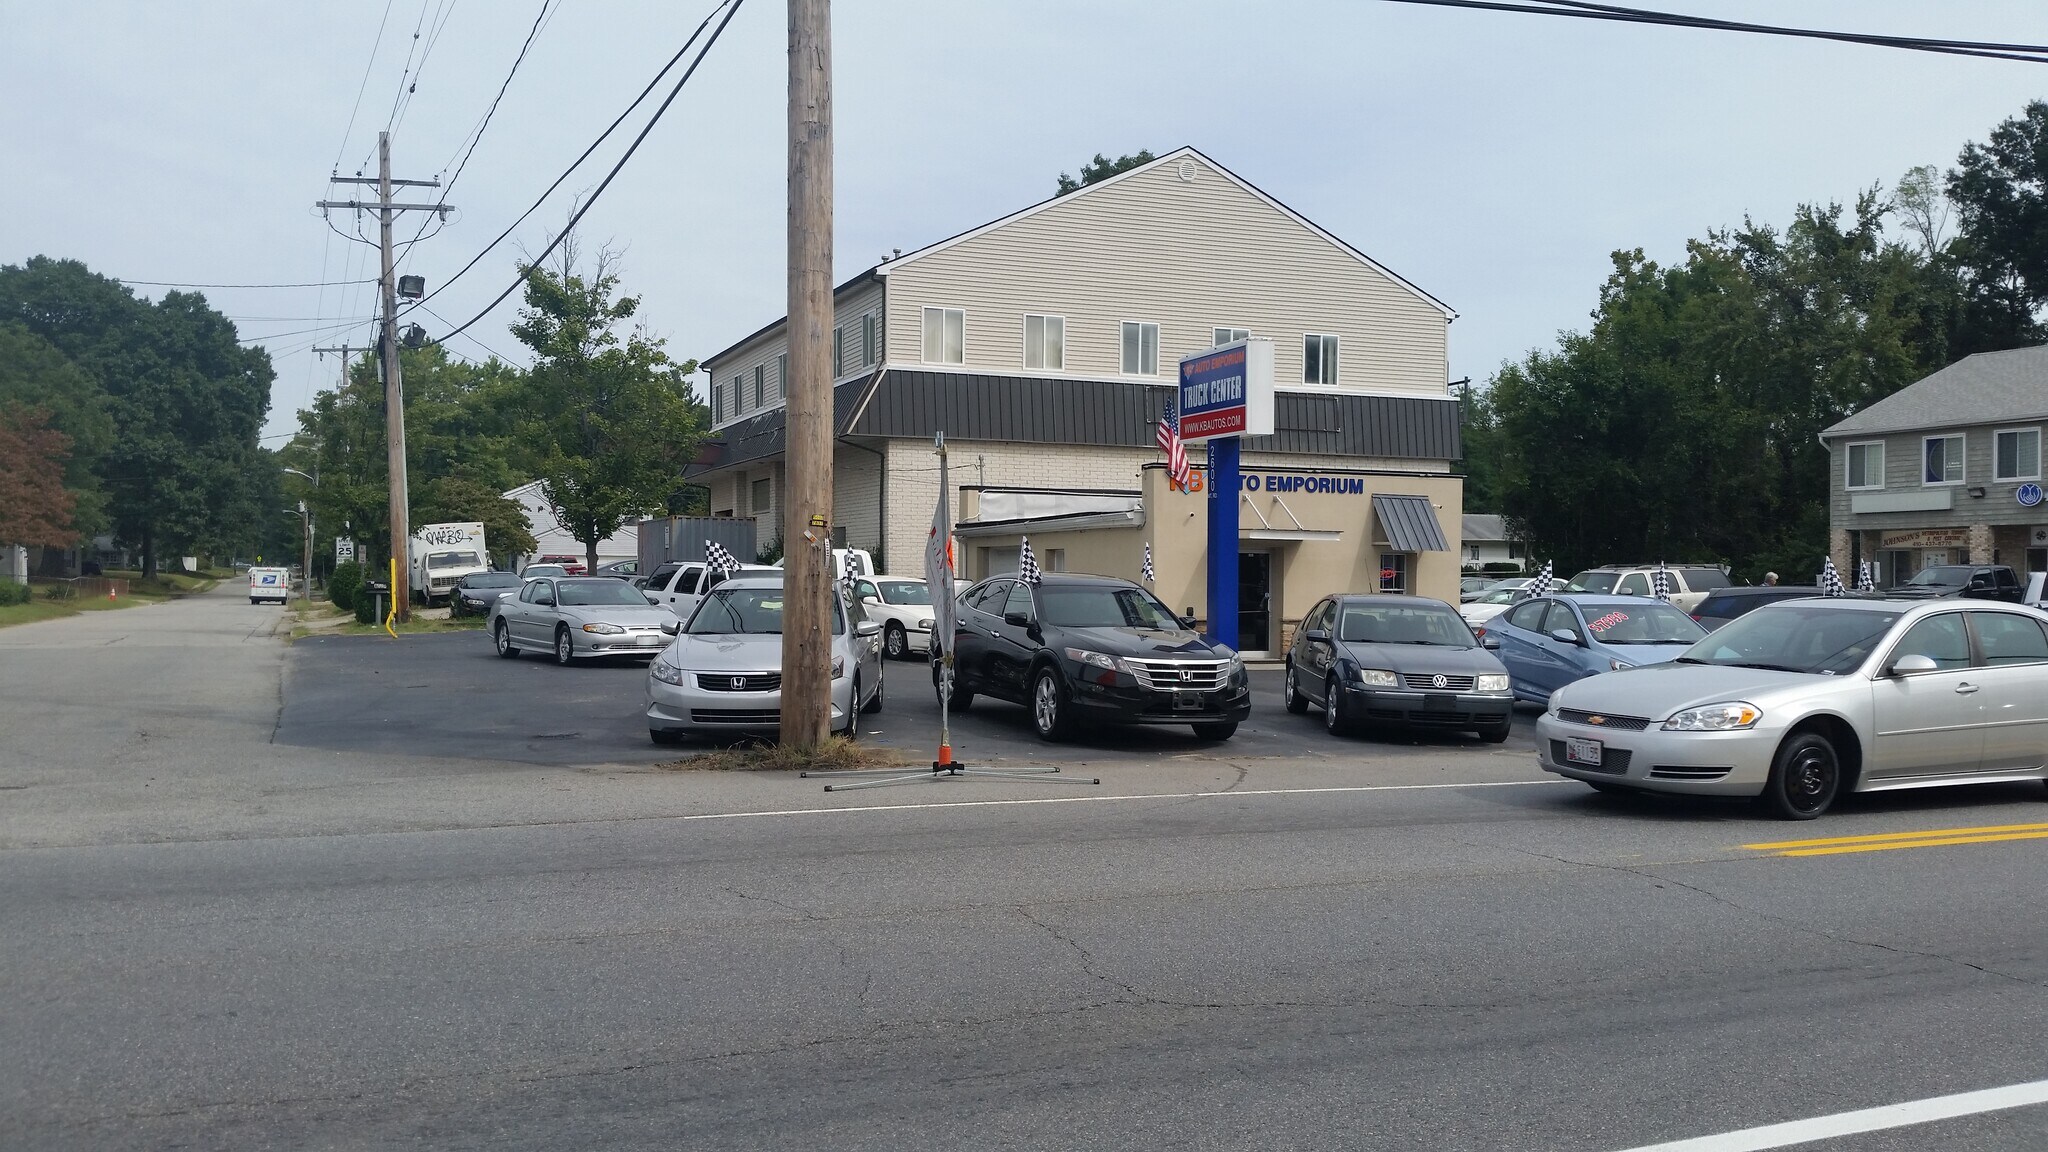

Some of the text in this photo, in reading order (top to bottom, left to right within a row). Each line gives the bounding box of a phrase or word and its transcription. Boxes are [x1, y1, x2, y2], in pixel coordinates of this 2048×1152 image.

[1195, 360, 1210, 374] AUTO
[1211, 351, 1245, 370] EMPORIUM
[1184, 376, 1242, 409] TRUCK CENTER
[1184, 415, 1241, 434] WWW.KBAUTOS.COM
[1266, 476, 1364, 494] EMPORIUM
[338, 547, 352, 555] 25
